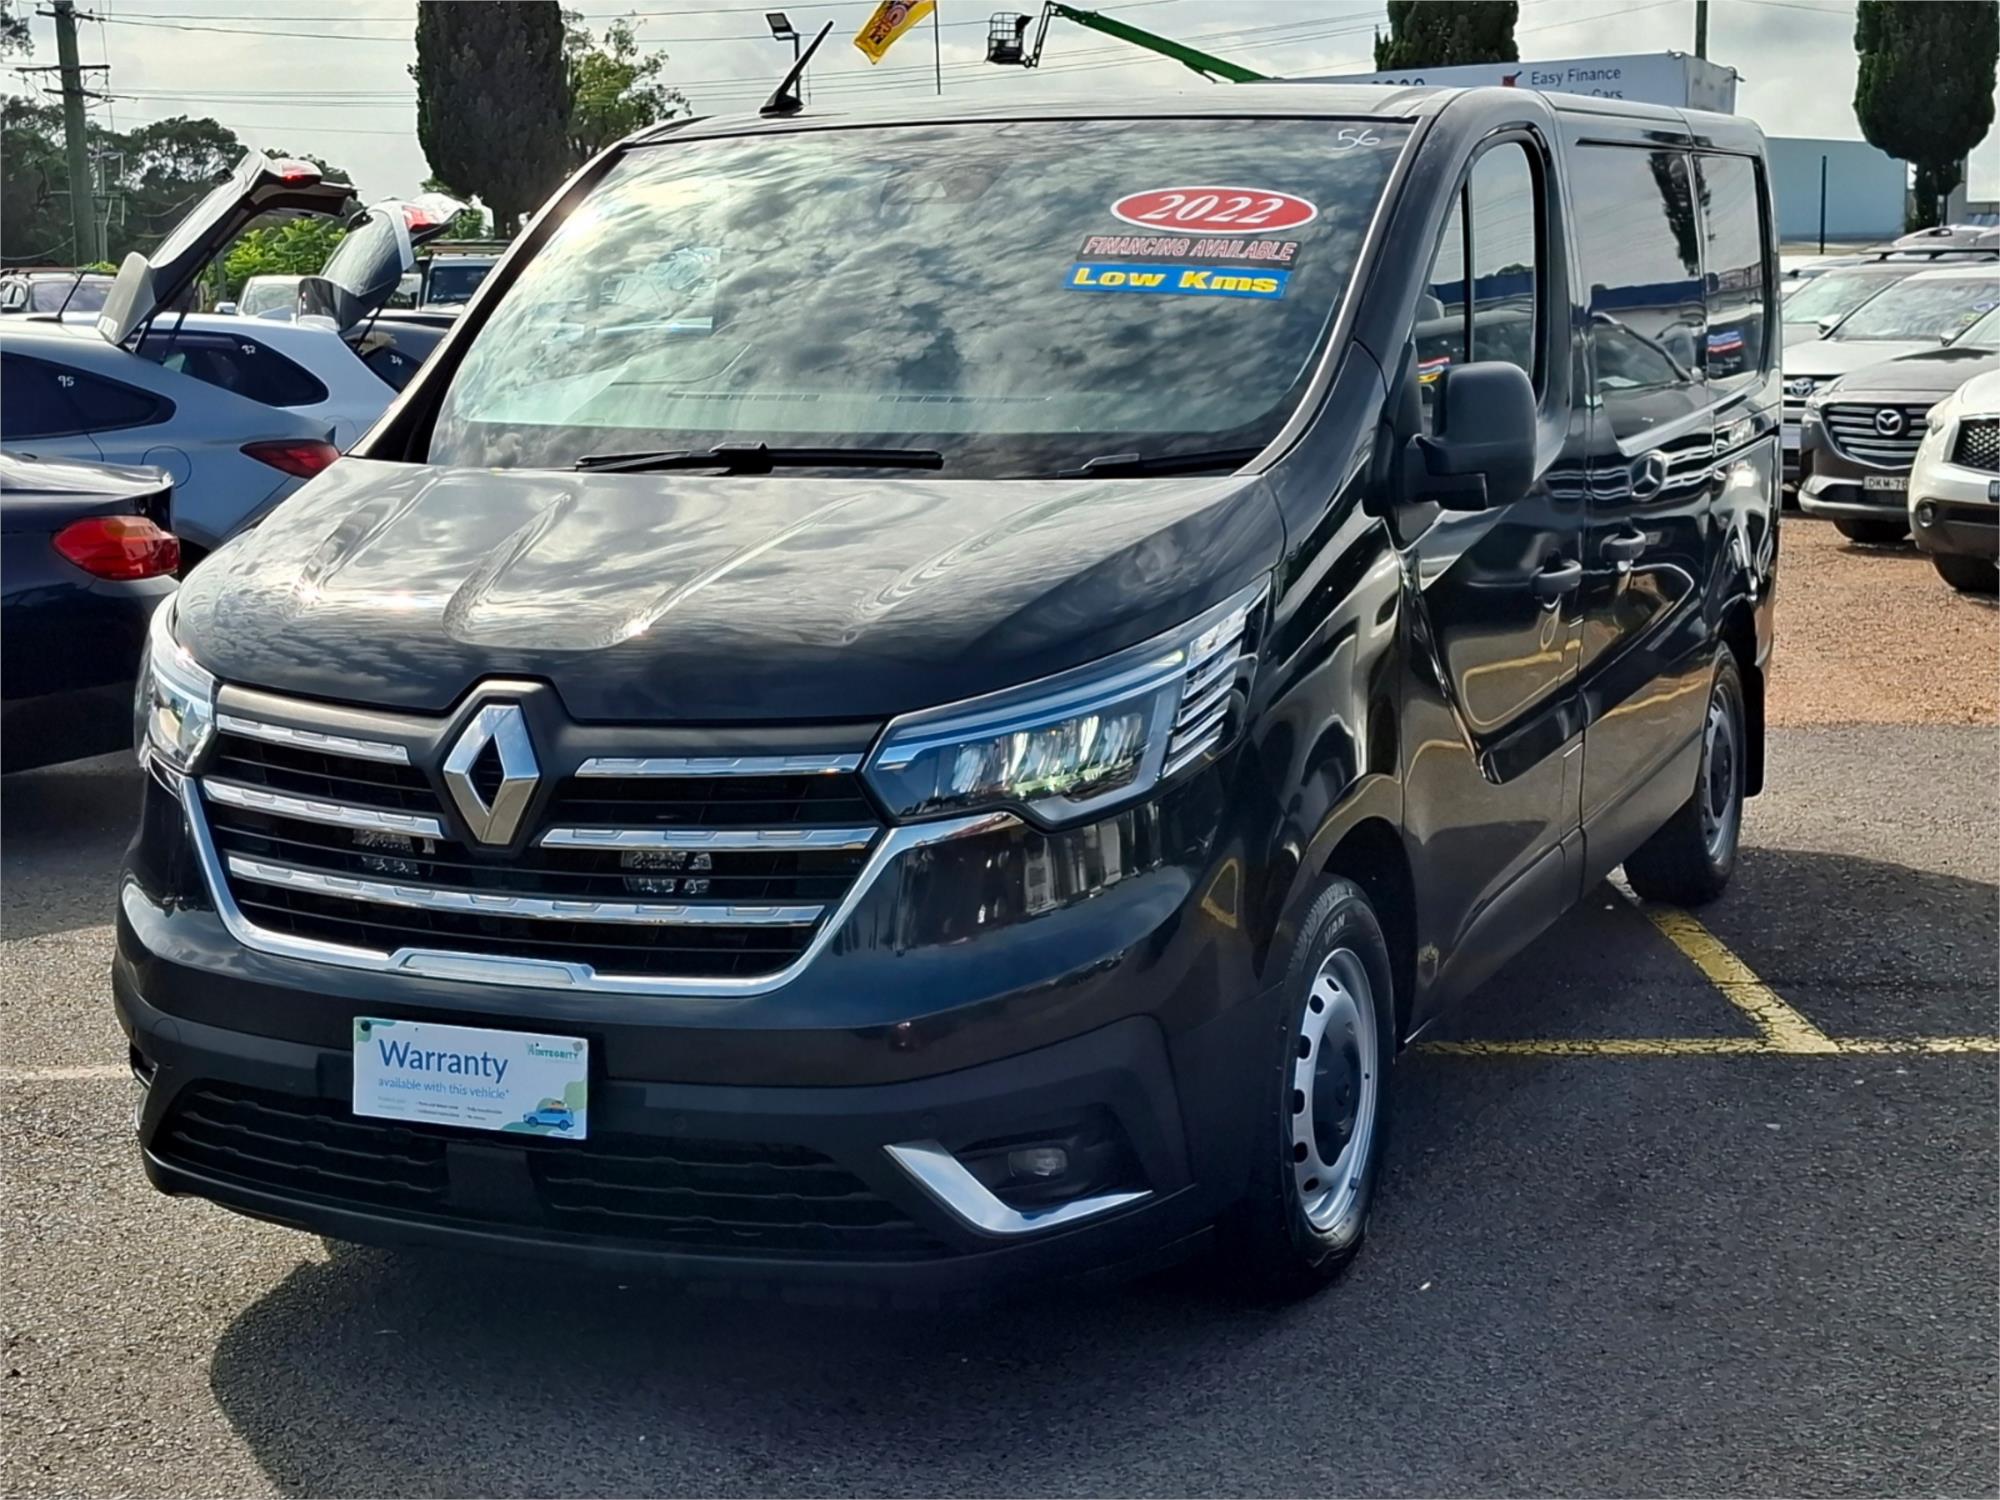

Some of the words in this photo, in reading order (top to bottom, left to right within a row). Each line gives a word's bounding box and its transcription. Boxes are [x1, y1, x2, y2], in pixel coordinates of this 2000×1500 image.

[1531, 70, 1563, 87] Easy
[1567, 67, 1621, 82] Finance
[1331, 128, 1381, 150] 56
[1137, 194, 1284, 224] 2022
[1083, 236, 1189, 257] FINANCING
[1189, 240, 1297, 260] AVAILABLE
[1073, 267, 1167, 287] Low
[1178, 271, 1279, 292] Kms
[378, 1039, 509, 1084] Warranty
[378, 1078, 421, 1092] available
[424, 1081, 446, 1094] with
[448, 1083, 468, 1096] this
